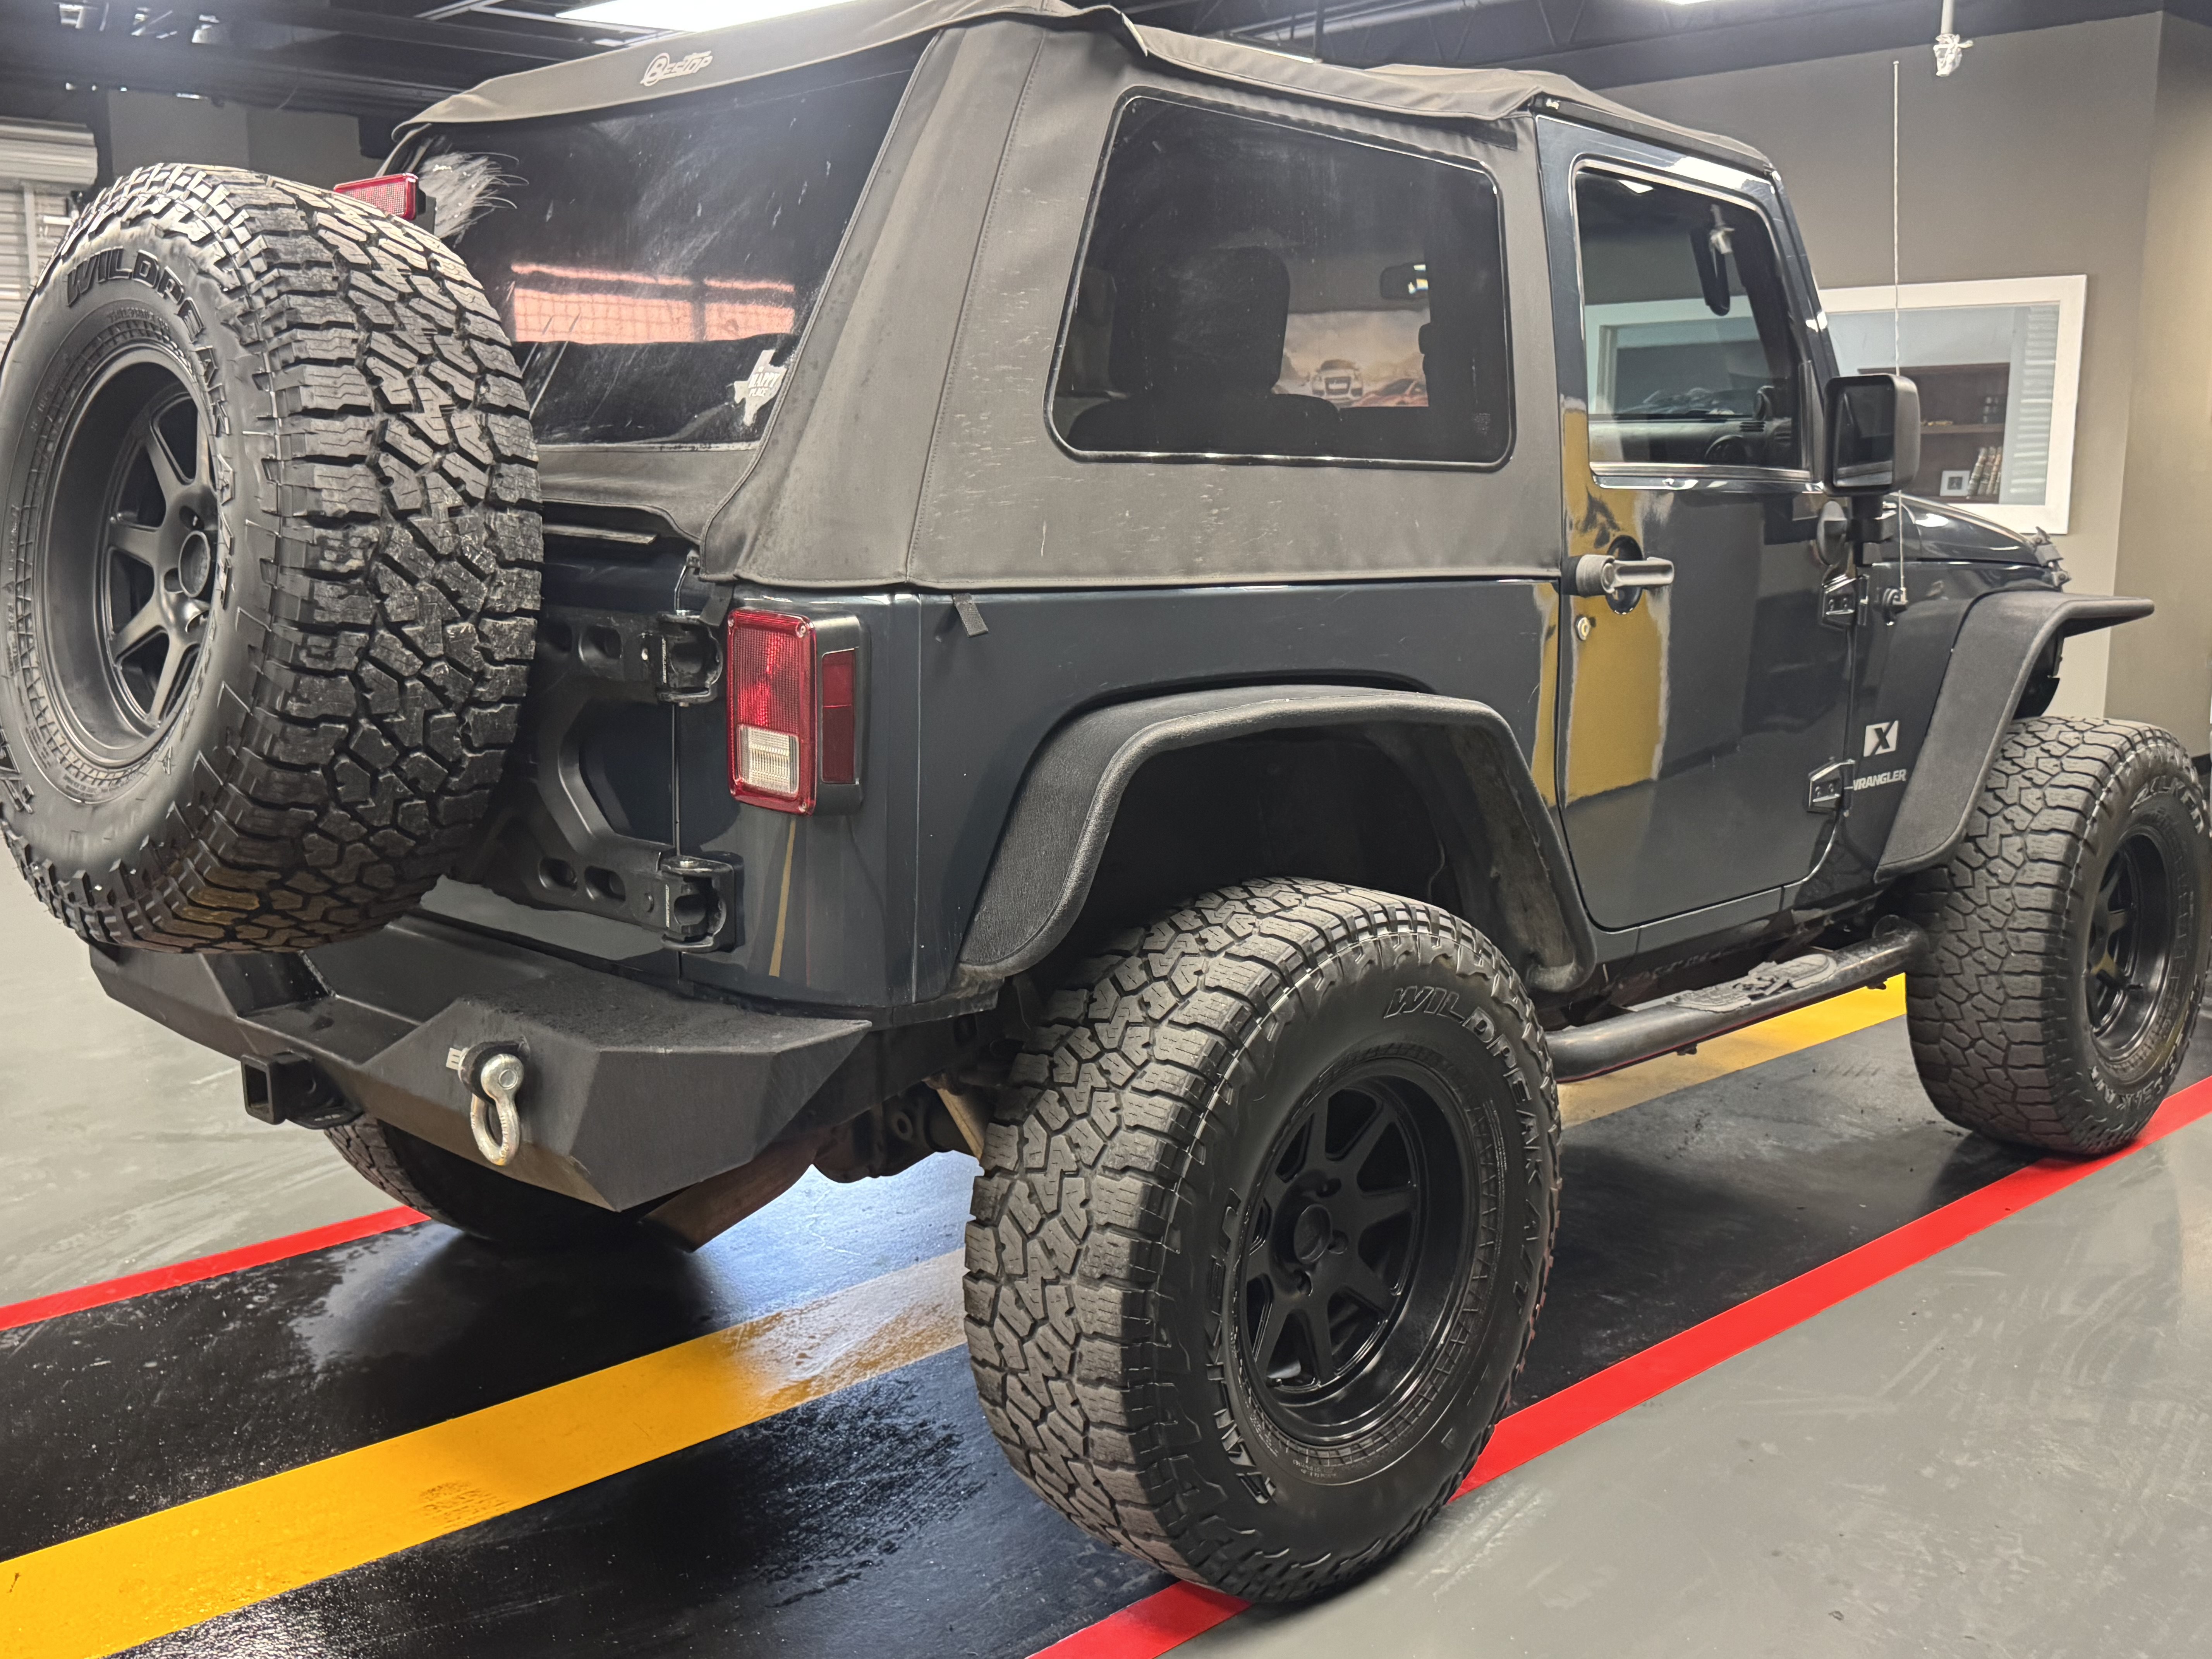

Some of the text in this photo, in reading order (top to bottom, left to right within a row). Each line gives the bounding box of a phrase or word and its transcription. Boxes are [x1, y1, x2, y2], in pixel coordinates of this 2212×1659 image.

[67, 246, 230, 436] WILDPEAK
[748, 372, 781, 388] HAPPY
[749, 387, 768, 397] PLACE
[1867, 722, 1897, 757] X
[1384, 986, 1543, 1184] WILDPEAK
